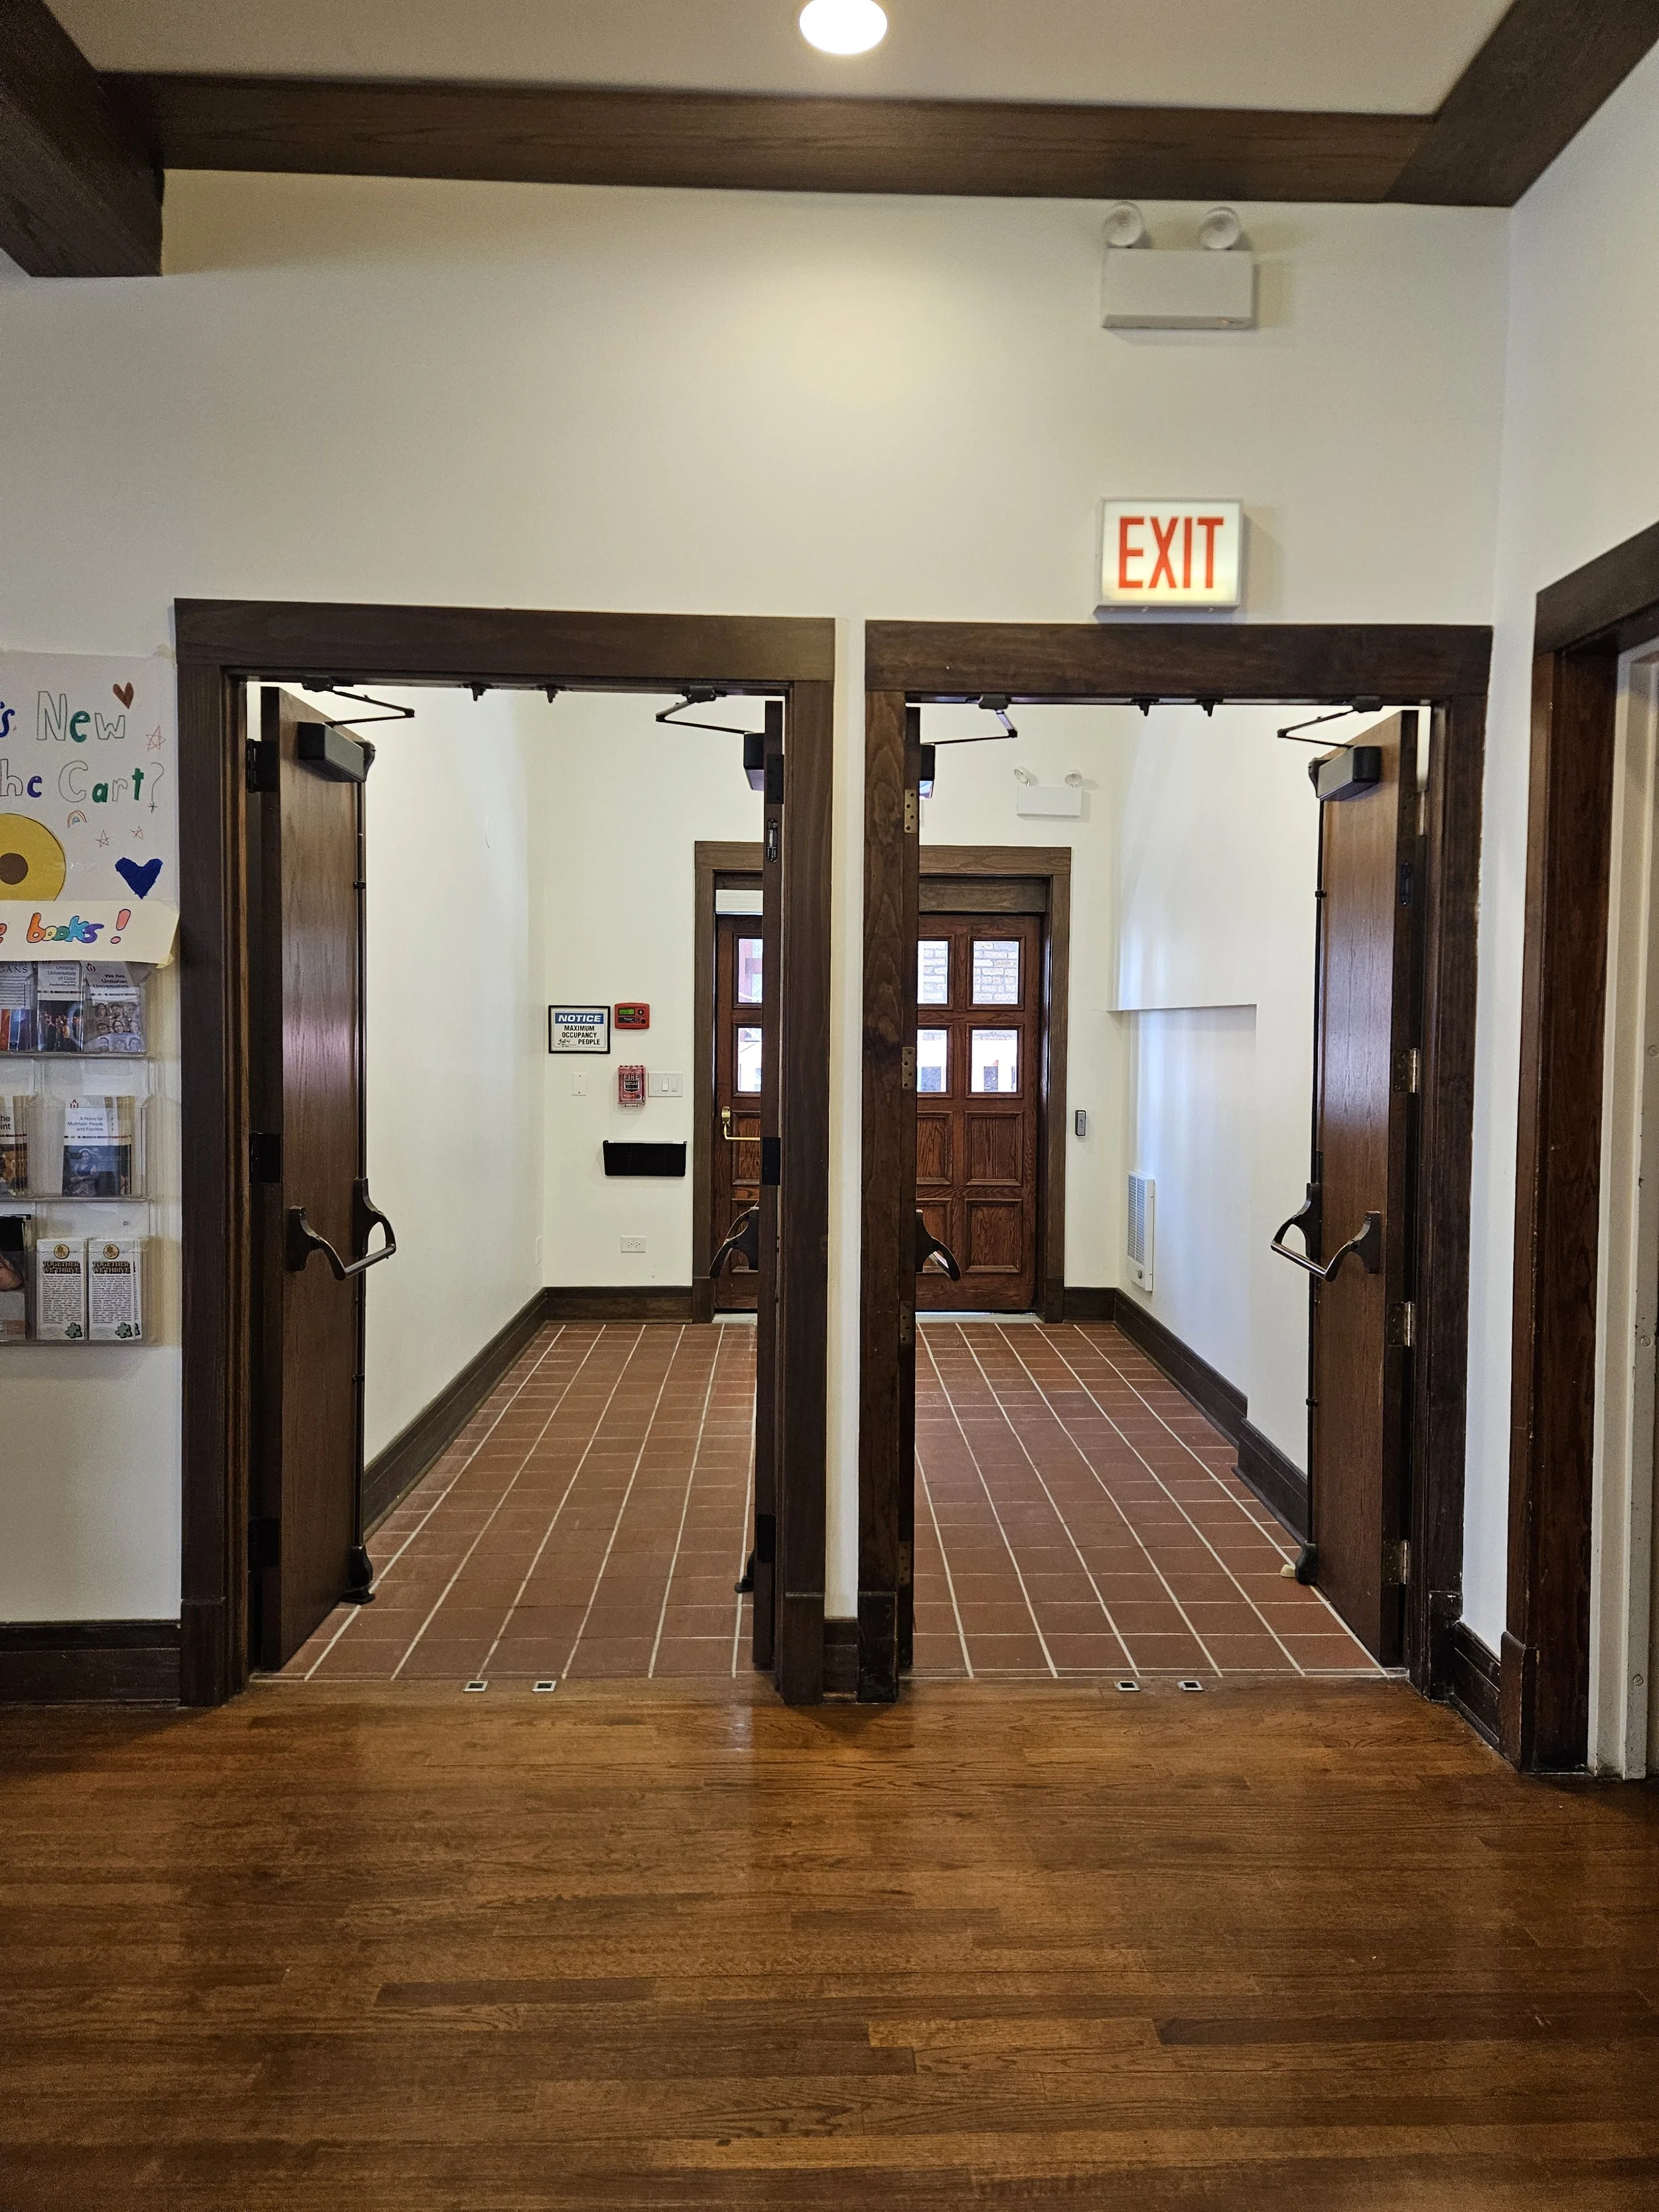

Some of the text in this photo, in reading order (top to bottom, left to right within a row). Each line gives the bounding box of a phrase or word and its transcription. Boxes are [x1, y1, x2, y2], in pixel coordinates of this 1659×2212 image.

[1118, 516, 1224, 589] EXIT
[36, 691, 126, 743] New
[58, 760, 165, 813] Cart?
